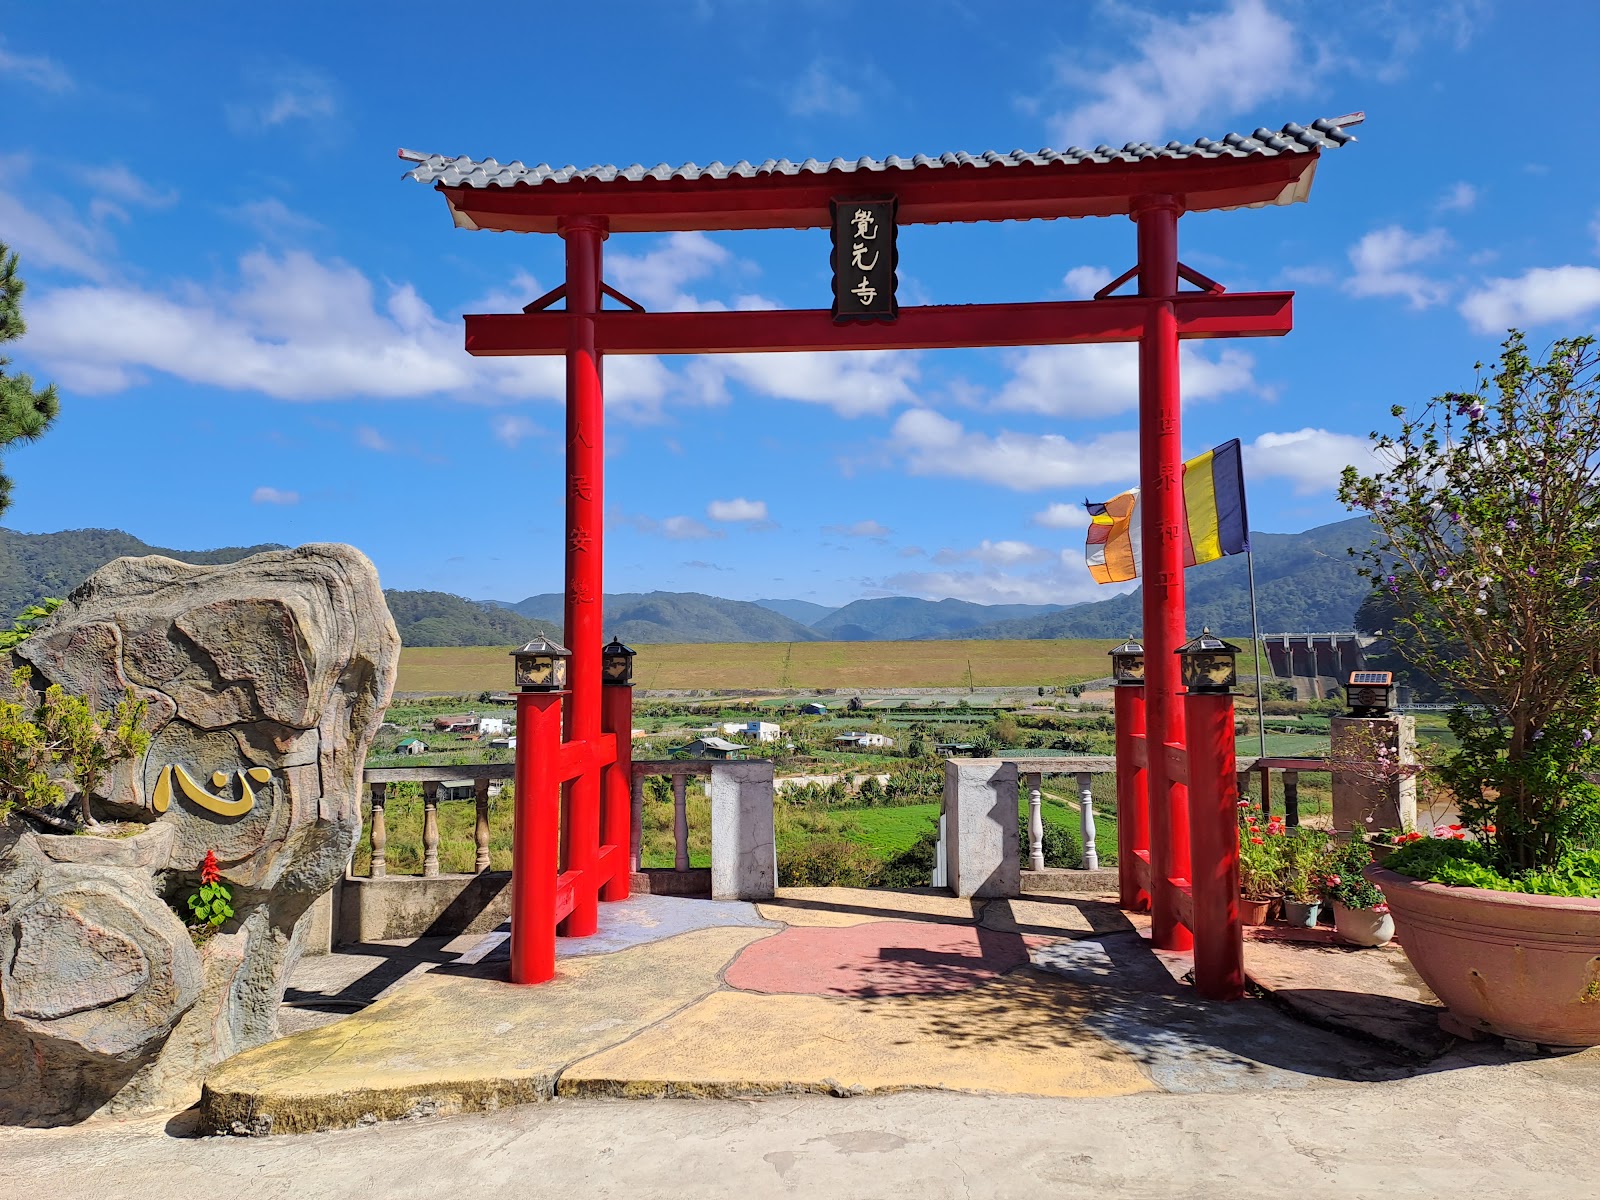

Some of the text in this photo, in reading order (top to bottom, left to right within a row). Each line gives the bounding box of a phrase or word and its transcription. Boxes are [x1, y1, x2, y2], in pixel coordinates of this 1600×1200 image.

[850, 208, 880, 306] 覺元寺
[152, 763, 272, 817] 心
